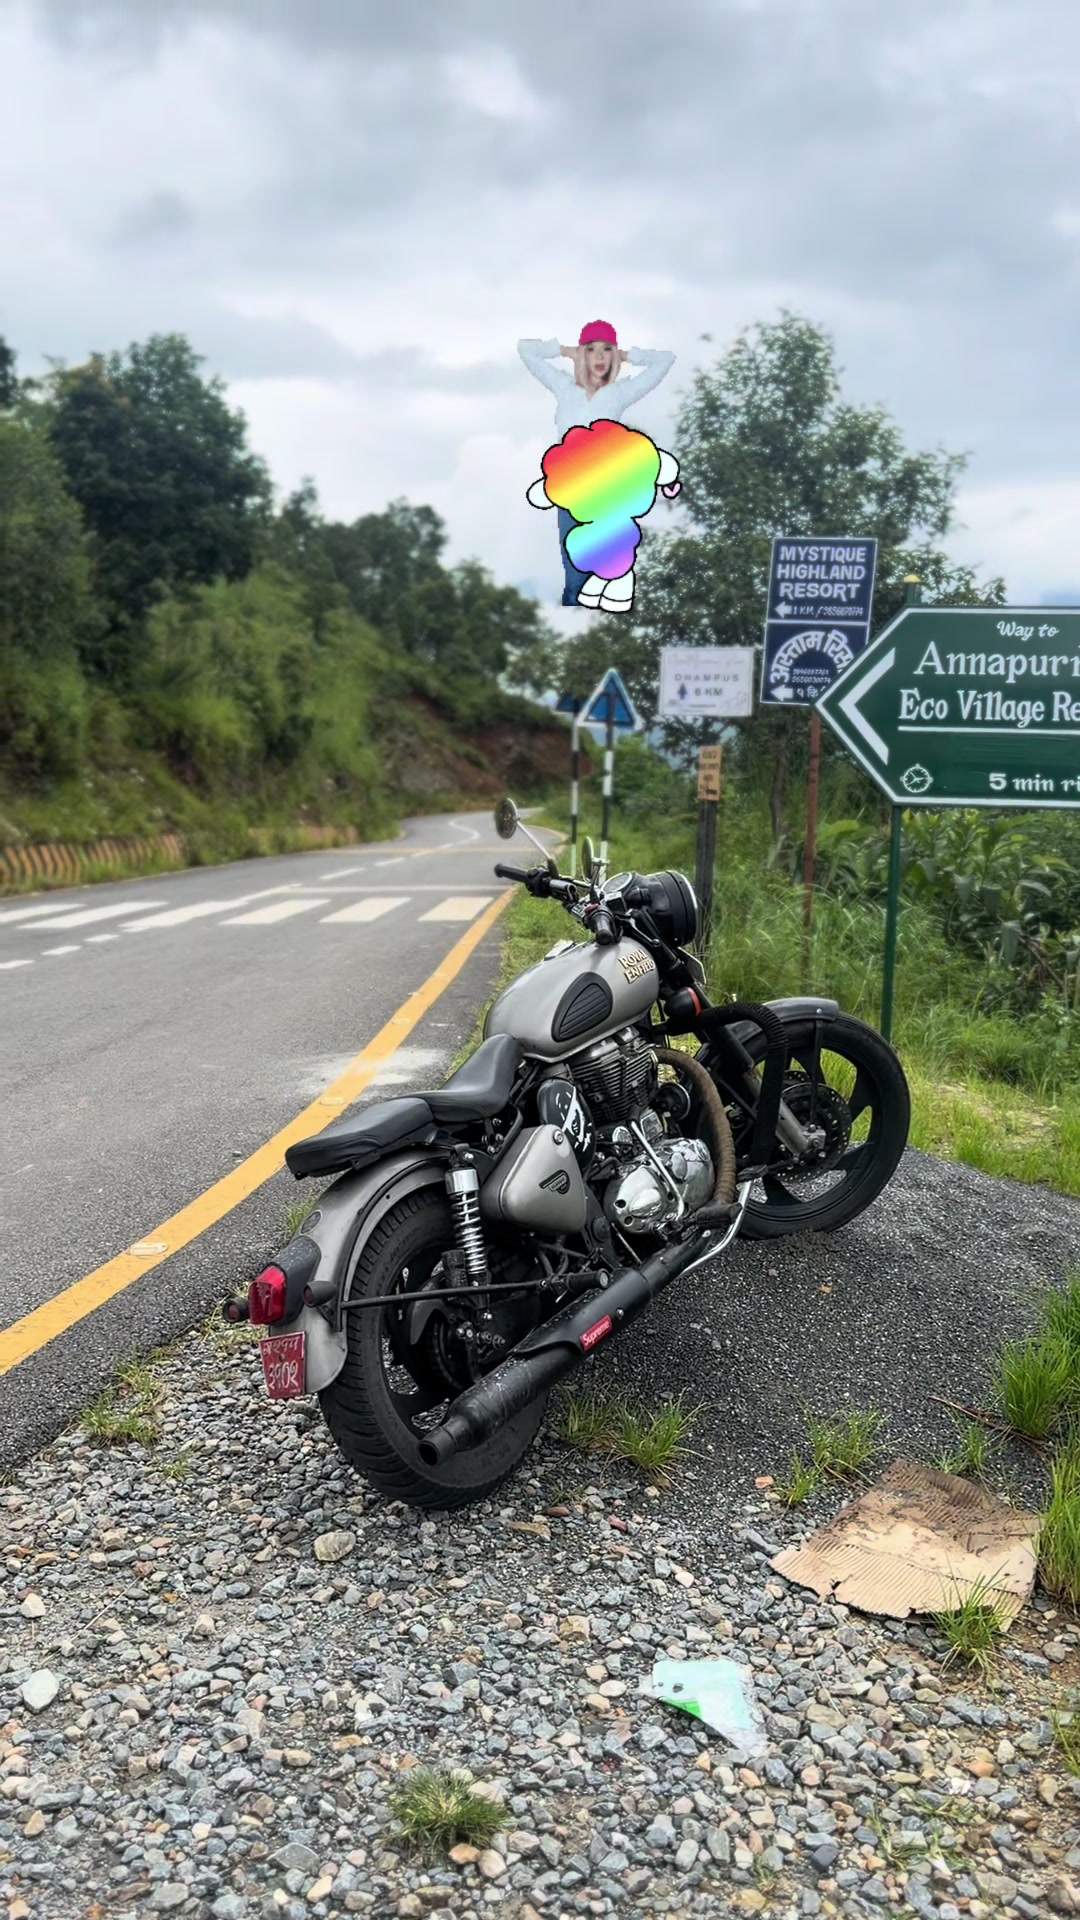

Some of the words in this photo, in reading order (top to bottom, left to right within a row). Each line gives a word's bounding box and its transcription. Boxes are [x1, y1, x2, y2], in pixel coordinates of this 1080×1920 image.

[780, 545, 867, 563] MYSTIQUE
[777, 563, 866, 580] HIGHLAND
[779, 582, 860, 602] RESORT
[996, 620, 1034, 641] Way
[1038, 624, 1060, 638] to
[823, 629, 855, 673] रिस
[674, 673, 740, 682] DHAMPUS
[694, 687, 702, 697] 6
[704, 687, 723, 697] KM
[898, 687, 949, 721] Eco
[956, 689, 1046, 729] Village
[989, 772, 1007, 791] 5
[1012, 773, 1054, 792] min
[618, 949, 648, 970] ROYAL
[582, 1320, 610, 1346] Supreme
